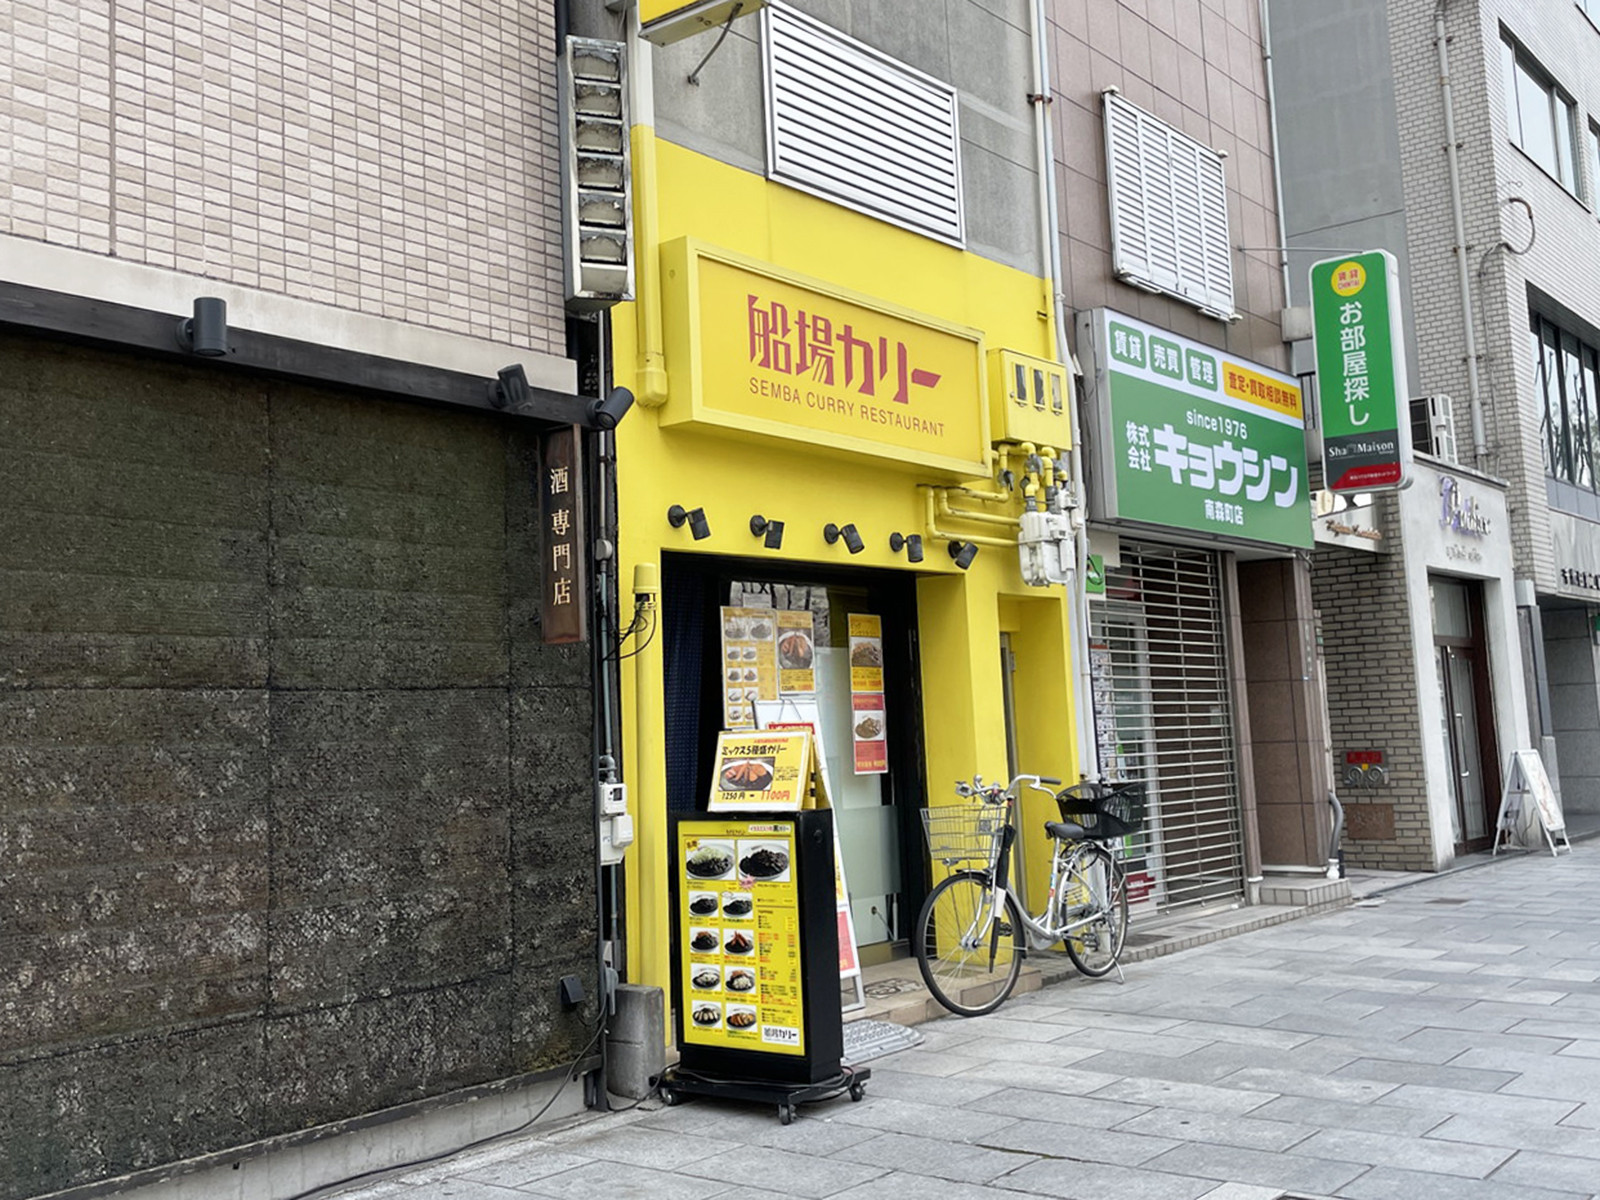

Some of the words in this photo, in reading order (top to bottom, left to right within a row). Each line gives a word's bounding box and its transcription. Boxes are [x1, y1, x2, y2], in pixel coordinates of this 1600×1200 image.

[747, 294, 942, 404] 船場カリー
[1114, 330, 1142, 362] 賃貸
[1153, 344, 1180, 373] 売買
[1190, 356, 1214, 384] 管理
[1339, 301, 1370, 426] お部屋探し
[750, 377, 801, 404] SEMBA
[806, 391, 855, 418] CURRY
[861, 406, 945, 437] RESTAURANT
[1126, 420, 1150, 447] 株式
[1128, 448, 1152, 472] 会社
[1153, 424, 1299, 508] キョウシン
[1204, 499, 1244, 525] 南森町店
[550, 466, 571, 606] 酒専門店
[761, 790, 790, 800] 1100円
